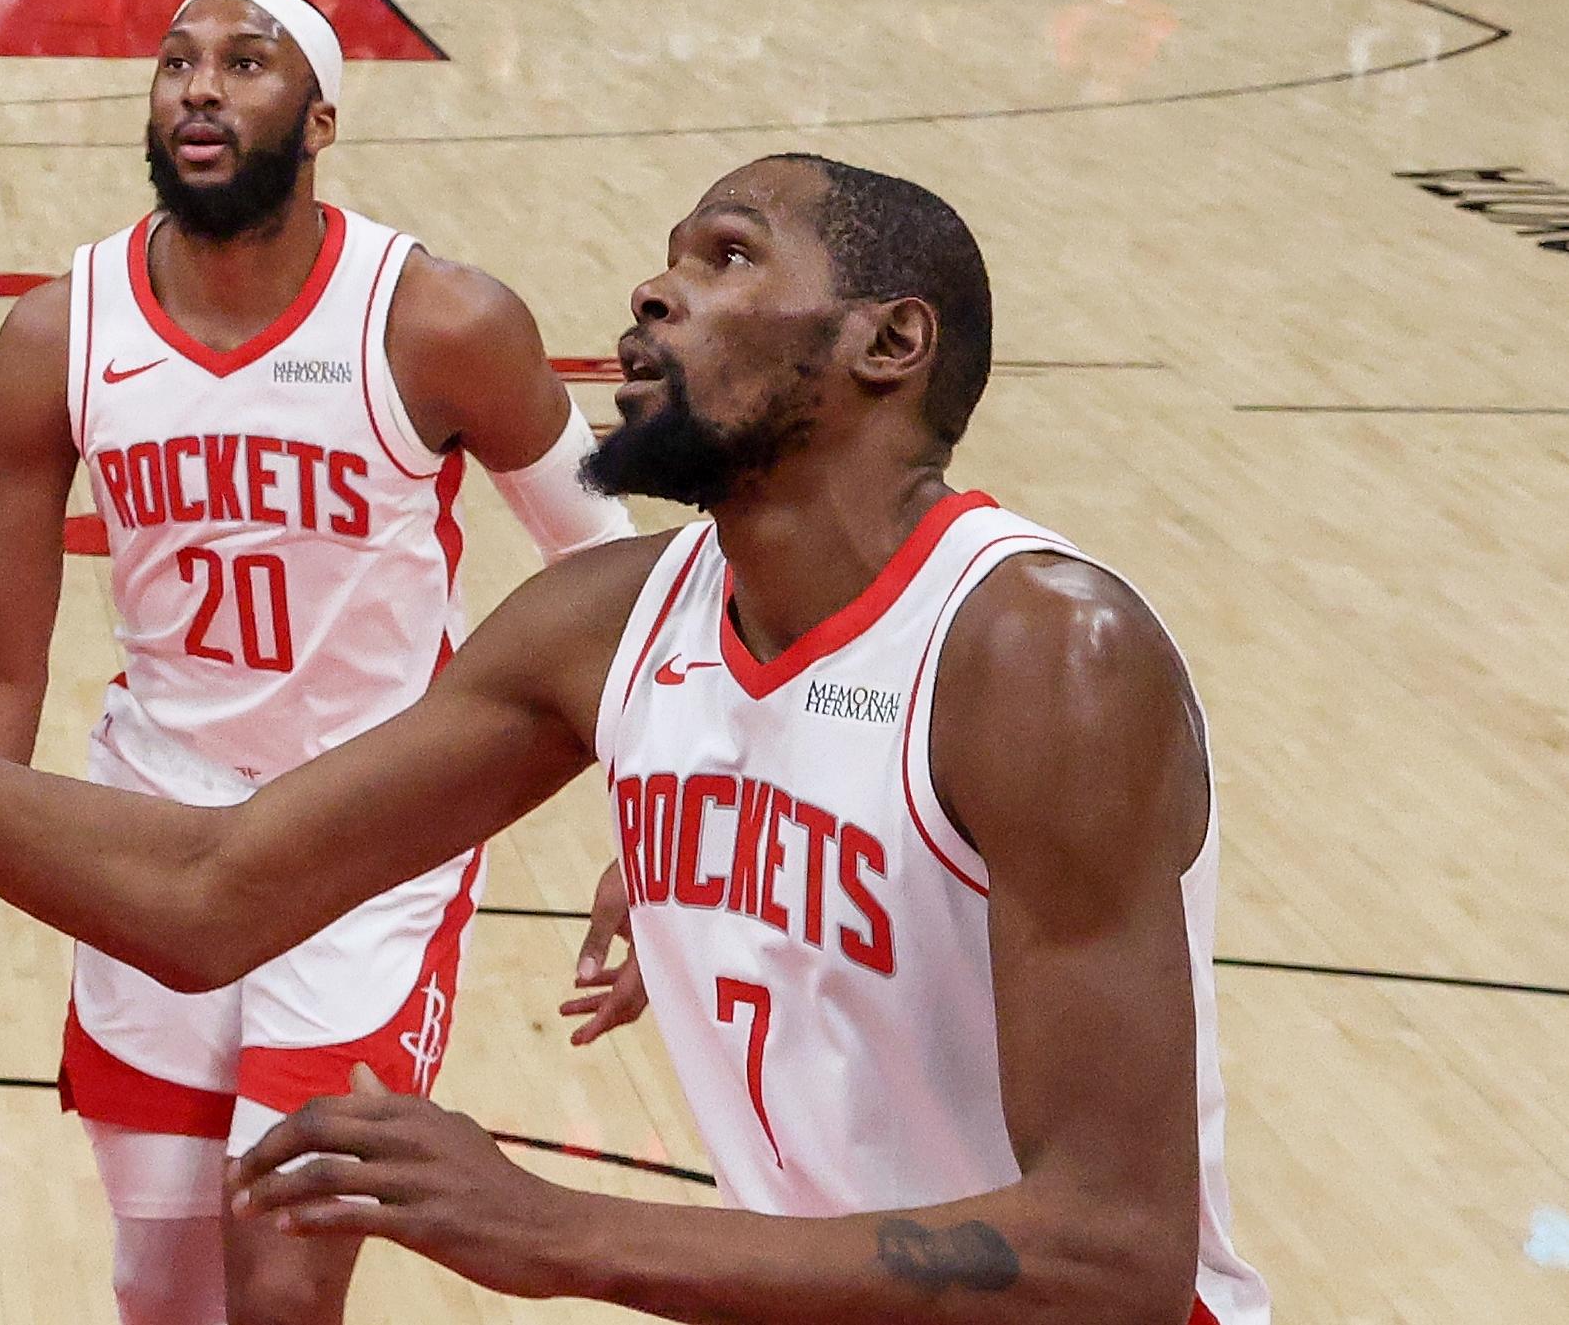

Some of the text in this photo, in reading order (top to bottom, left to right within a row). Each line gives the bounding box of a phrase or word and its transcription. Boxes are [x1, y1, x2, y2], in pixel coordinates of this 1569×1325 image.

[273, 360, 352, 374] MEMORIAL
[273, 370, 353, 384] HERMANN
[97, 434, 369, 538] ROCKETS
[176, 546, 294, 674] 20
[804, 696, 898, 724] HERMANN
[807, 679, 901, 710] MEMORIAL
[615, 773, 896, 977] ROCKETS
[715, 976, 784, 1171] 7
